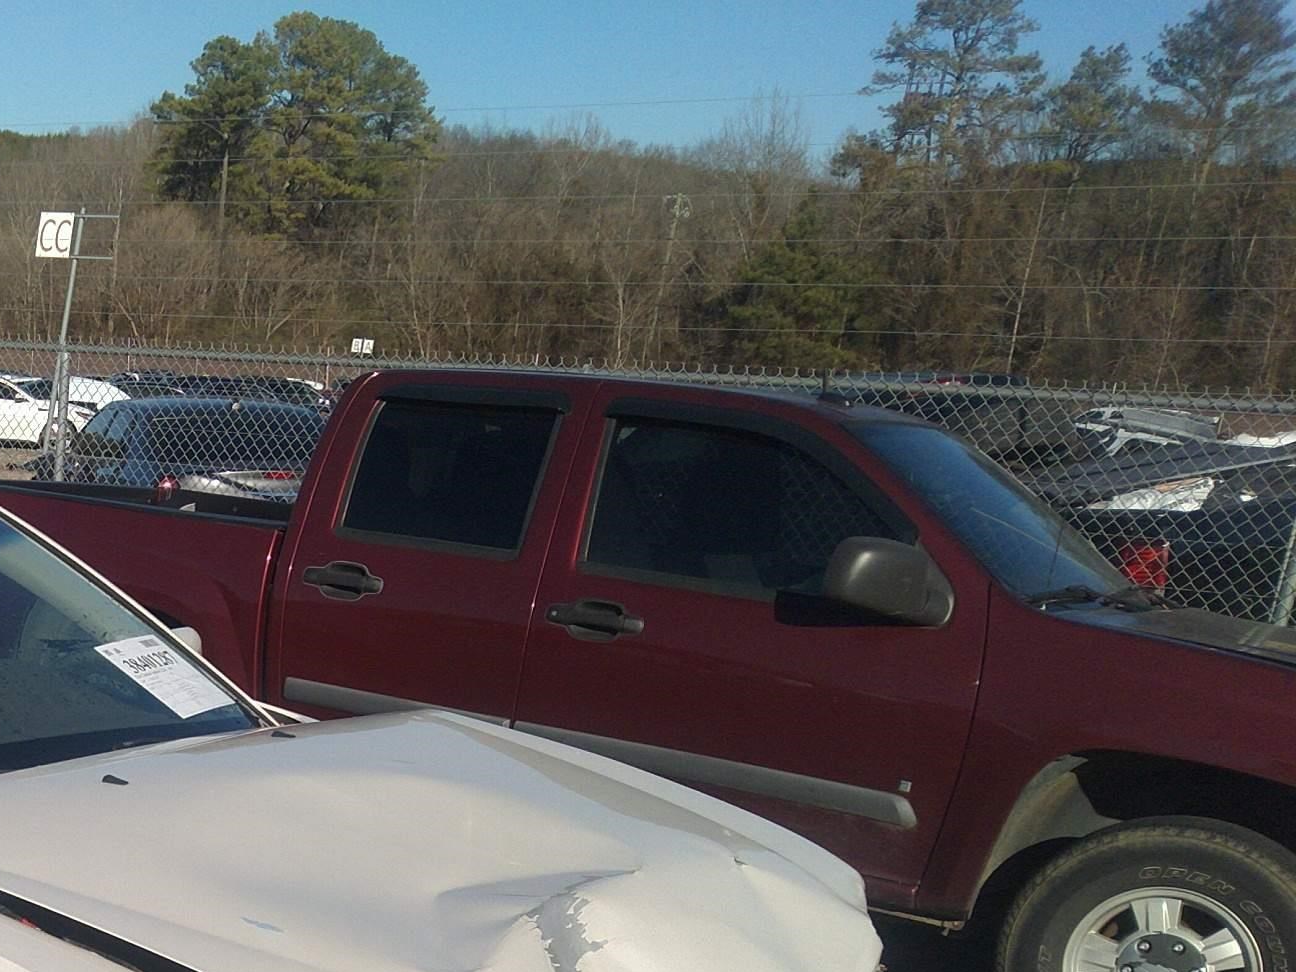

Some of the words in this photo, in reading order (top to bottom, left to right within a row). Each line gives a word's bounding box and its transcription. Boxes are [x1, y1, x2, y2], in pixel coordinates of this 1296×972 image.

[40, 218, 72, 253] CC
[121, 650, 179, 675] 38401287
[1138, 866, 1237, 896] OPEN
